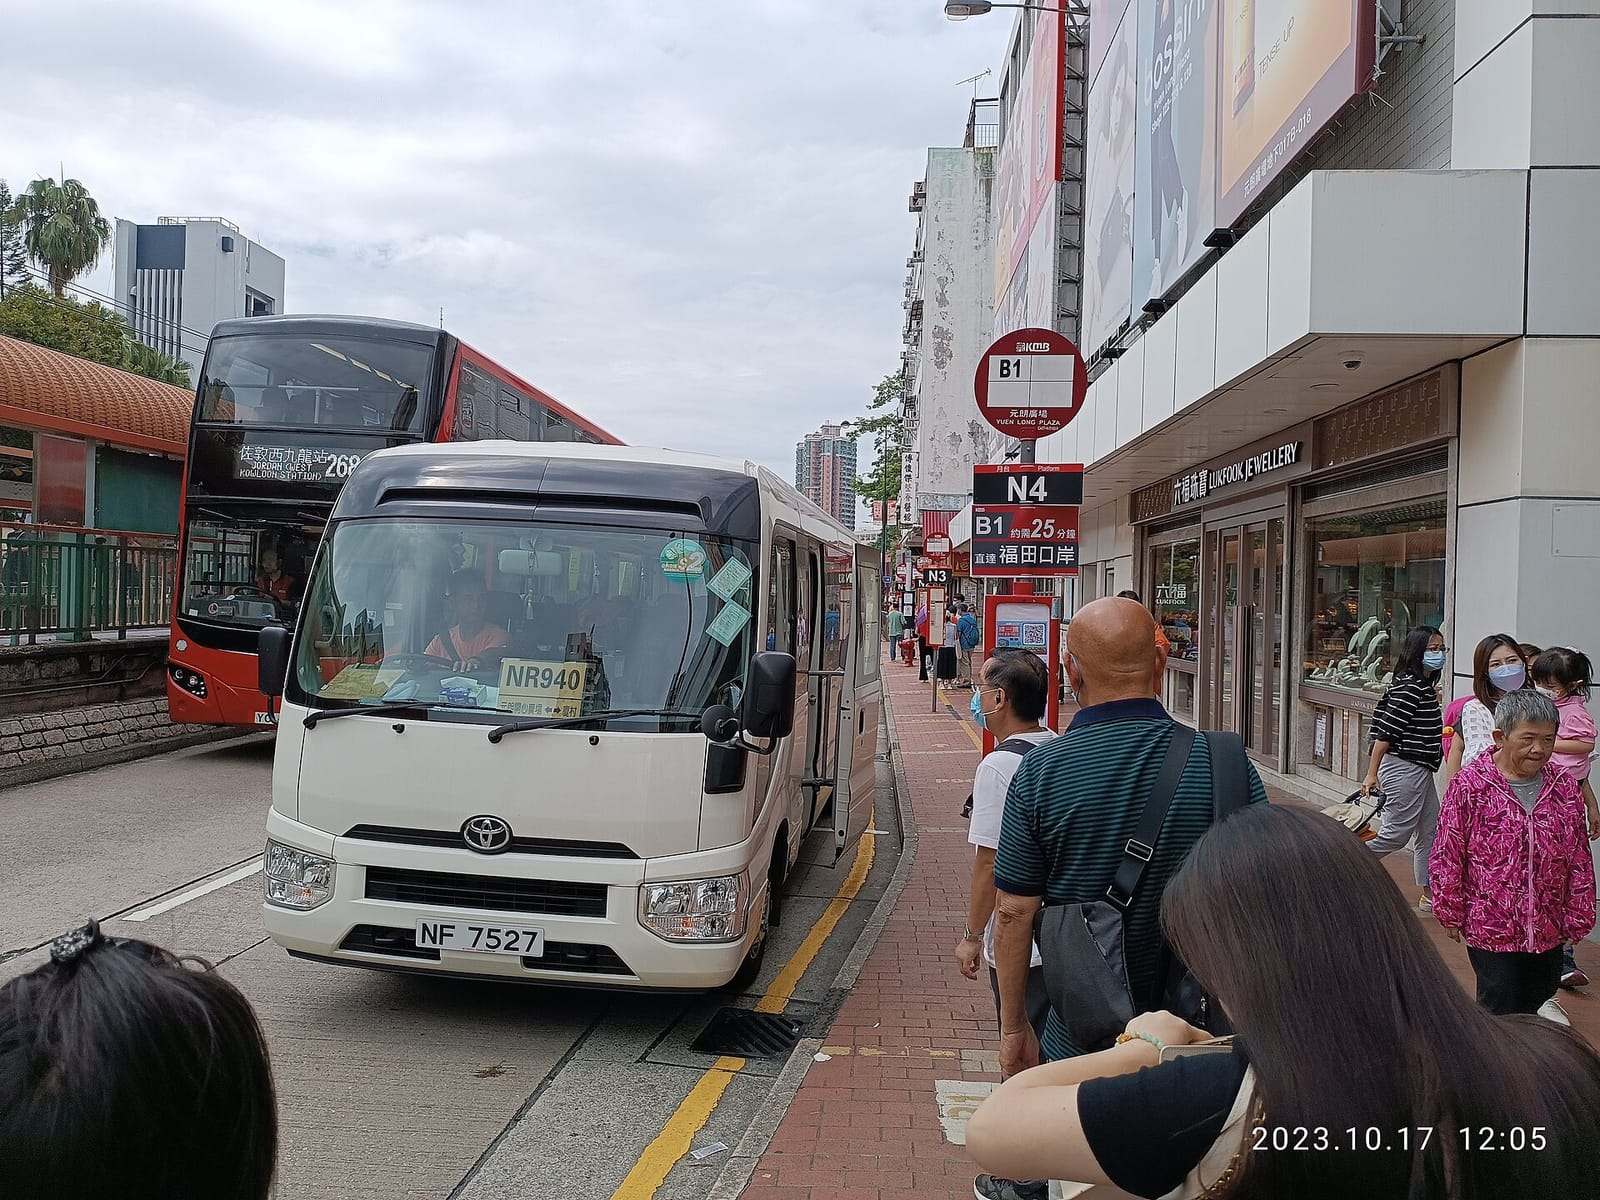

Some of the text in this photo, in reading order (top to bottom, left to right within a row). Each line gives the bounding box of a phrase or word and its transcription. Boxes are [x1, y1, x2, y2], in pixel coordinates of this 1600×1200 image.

[1283, 15, 1295, 42] UP
[999, 359, 1021, 378] B1
[1009, 409, 1048, 418] 元朗廣場
[239, 468, 322, 480] KOWLOON STATION)
[251, 461, 282, 471] JORDAN
[1174, 441, 1298, 506] 六福珠寶 LUKFOOK JEWELLERY
[1007, 475, 1048, 502] N4
[975, 516, 1003, 535] B1
[998, 545, 1076, 565] 福田口岸
[928, 569, 947, 582] N3
[1156, 583, 1187, 599] 六福
[505, 664, 581, 690] NR940
[421, 923, 538, 953] NF 7527
